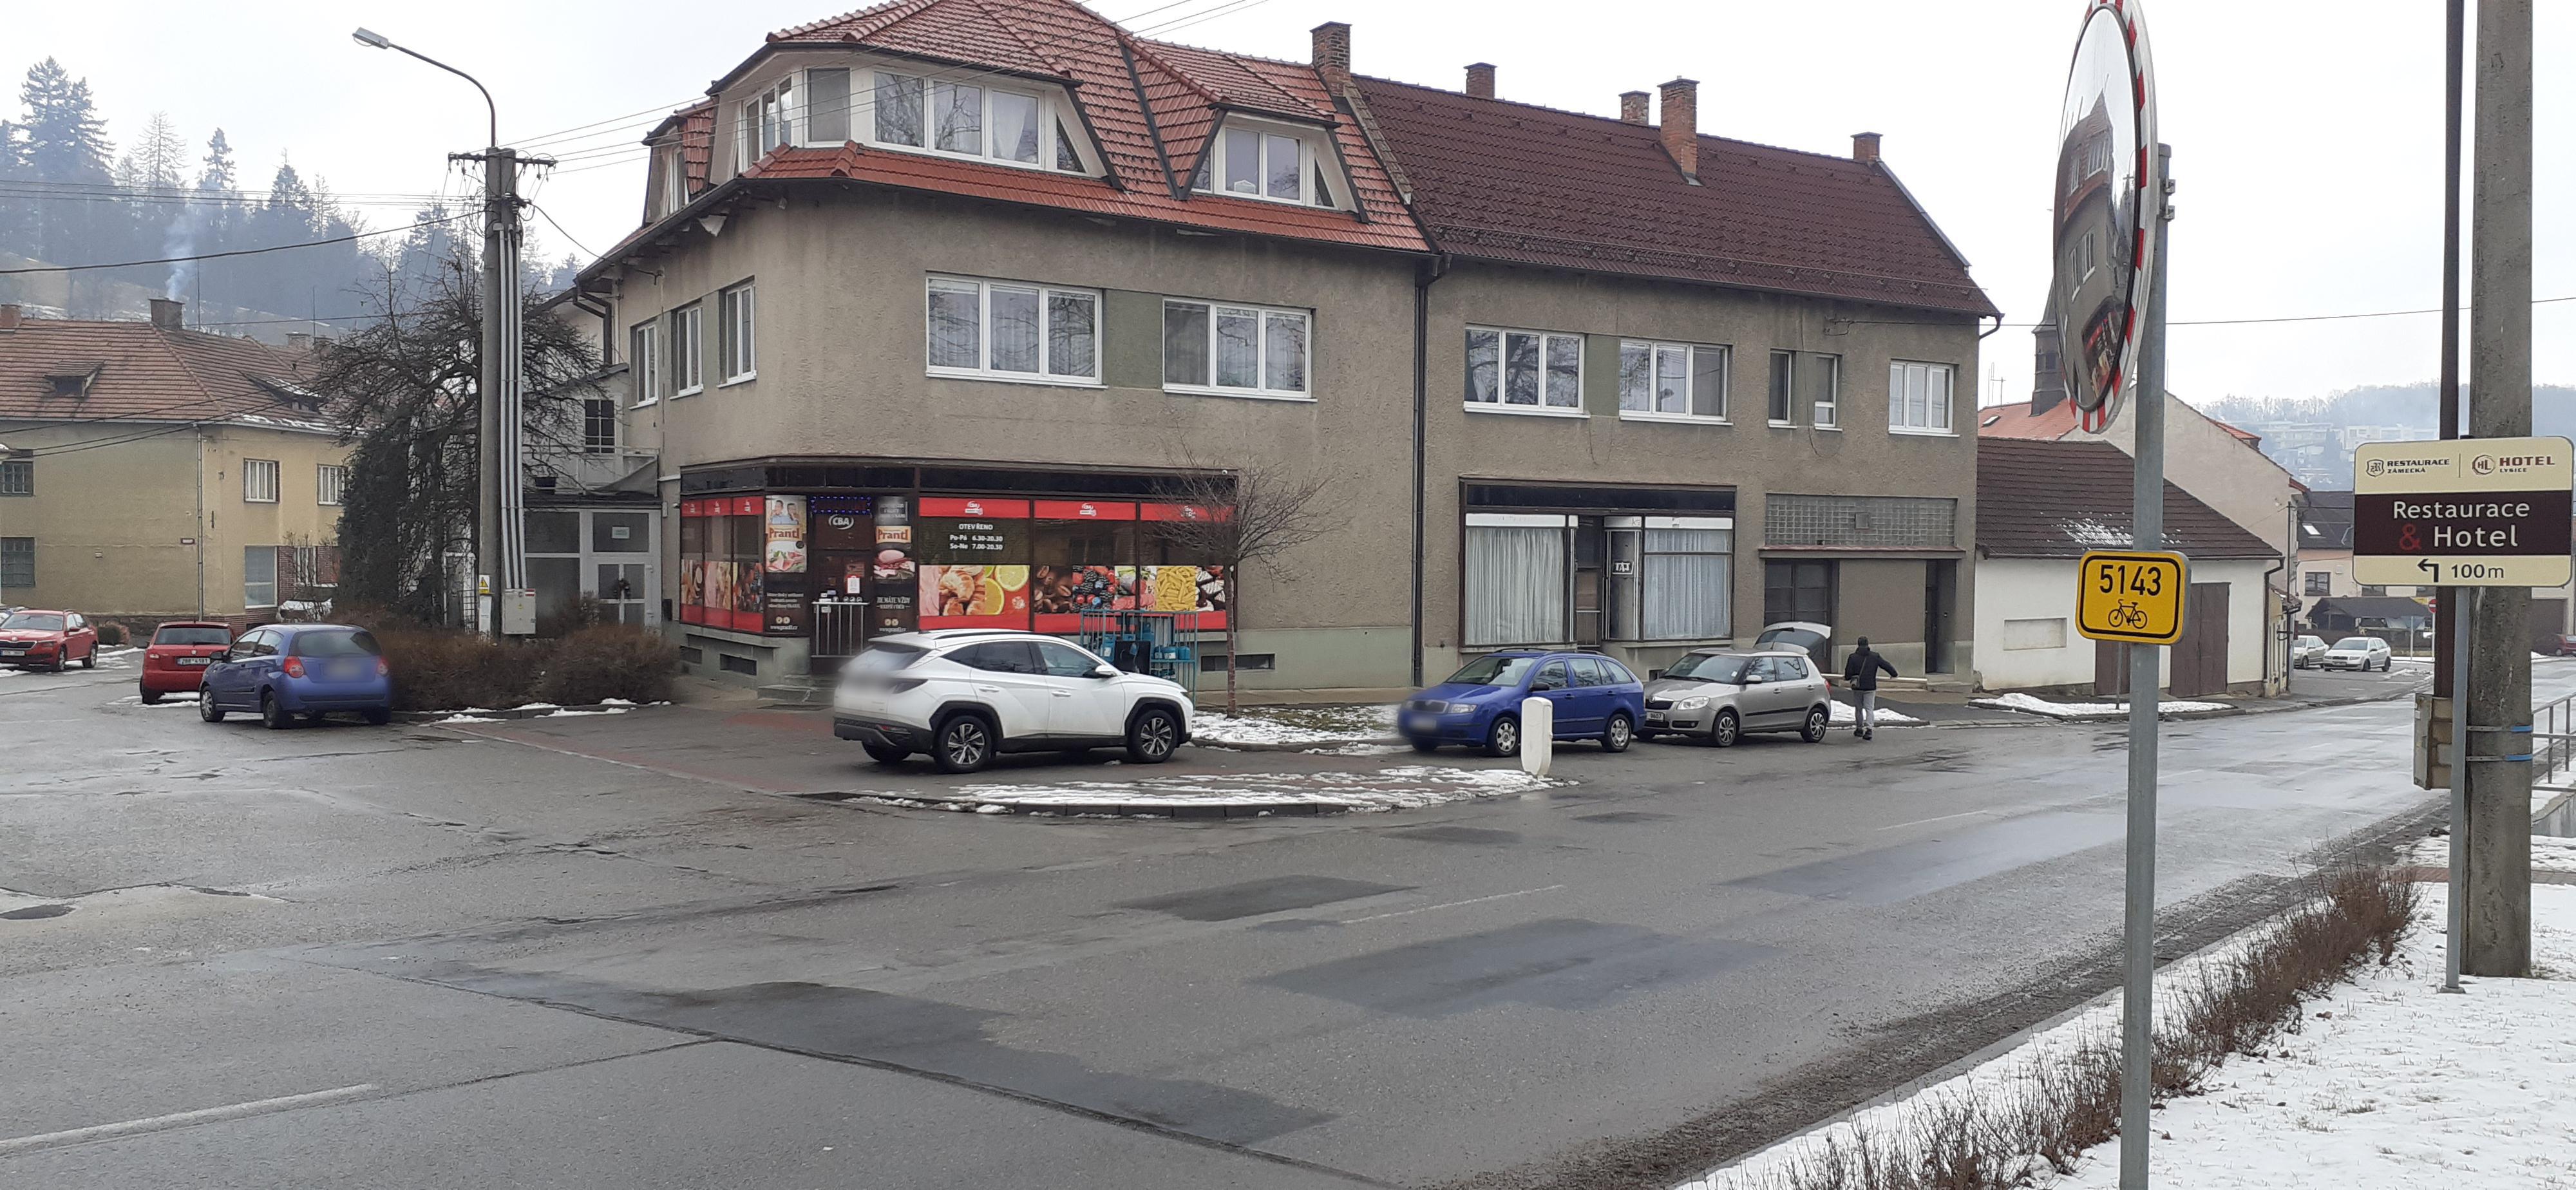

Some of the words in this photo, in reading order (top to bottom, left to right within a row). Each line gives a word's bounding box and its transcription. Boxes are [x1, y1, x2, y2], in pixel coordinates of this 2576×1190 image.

[2499, 457, 2555, 466] HOTEL
[2393, 501, 2530, 519] Restaurace
[769, 527, 800, 539] Prantl
[877, 529, 909, 540] Prantl
[2400, 524, 2421, 551] &
[2434, 525, 2519, 547] Hotel
[2451, 564, 2485, 578] 100
[2099, 565, 2161, 596] 5143
